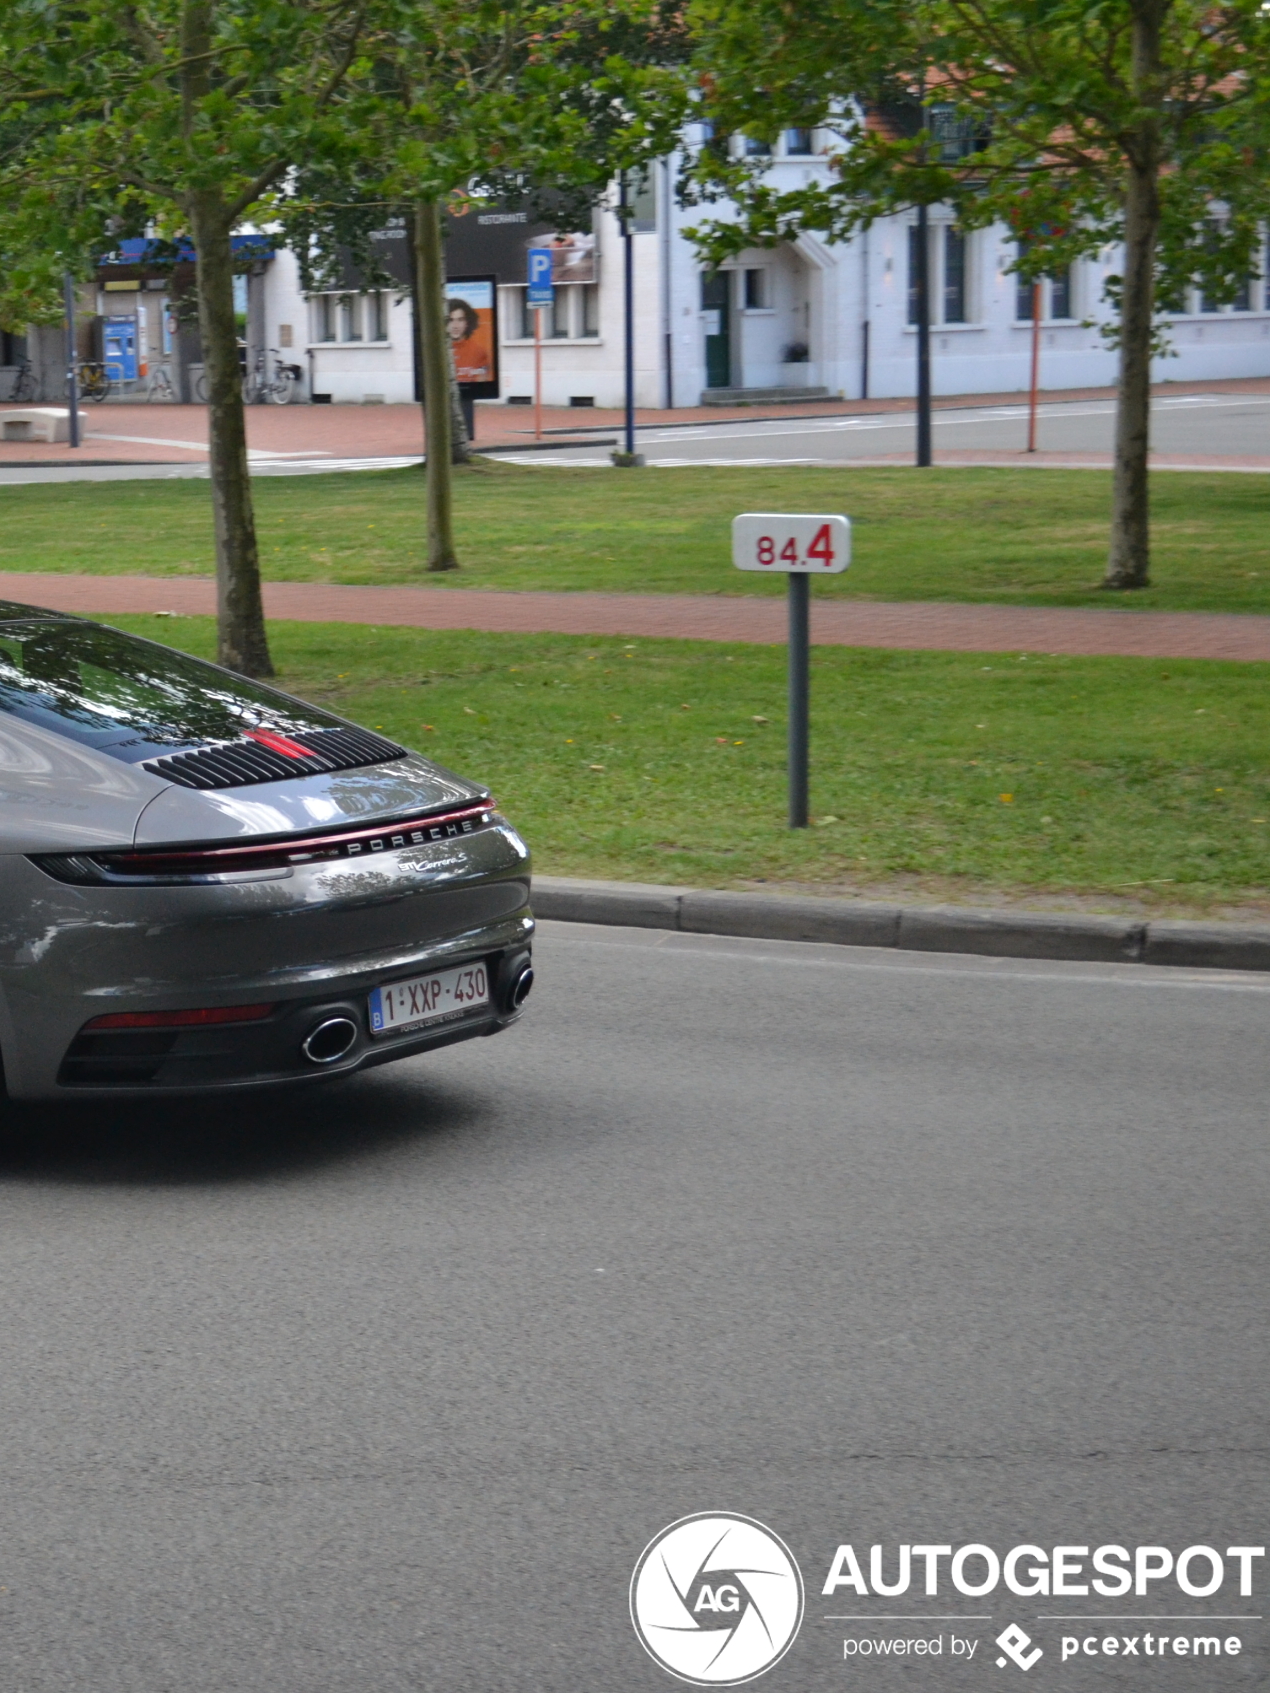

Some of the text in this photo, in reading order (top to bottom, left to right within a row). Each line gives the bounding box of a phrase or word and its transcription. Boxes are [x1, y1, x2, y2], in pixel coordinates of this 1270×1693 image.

[531, 255, 550, 282] P
[757, 523, 835, 567] 84.4
[347, 821, 473, 855] PORSCHE
[415, 857, 457, 872] Carrera
[373, 1012, 382, 1027] B
